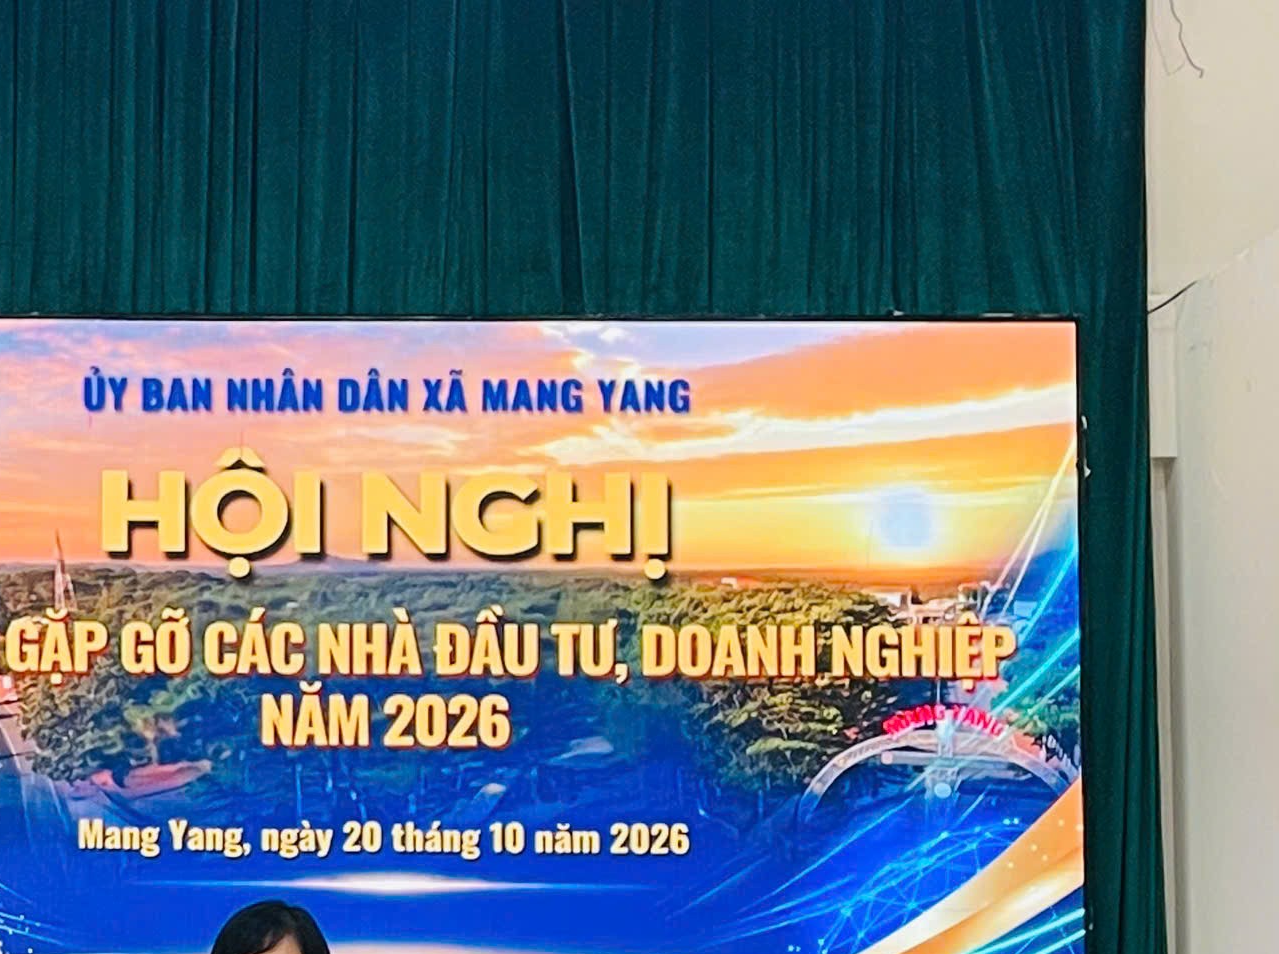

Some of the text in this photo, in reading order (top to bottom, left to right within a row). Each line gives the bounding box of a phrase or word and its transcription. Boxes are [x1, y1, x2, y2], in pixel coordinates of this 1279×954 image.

[84, 365, 692, 415] ỦY BAN NHÂN DÂN XÃ MANG YANG
[101, 447, 675, 580] HỘI NGHỊ
[5, 606, 109, 684] GẶP
[122, 607, 191, 675] GỠ
[204, 606, 306, 676] CÁC
[319, 606, 422, 677] NHÀ
[432, 605, 539, 677] ĐẦU
[550, 620, 628, 684] TƯ,
[641, 622, 817, 678] DOANH
[831, 617, 1017, 690] NGHIỆP
[260, 681, 512, 749] NĂM 2026
[78, 819, 690, 860] Mang Yang, ngày 20 tháng 10 năm 2026
